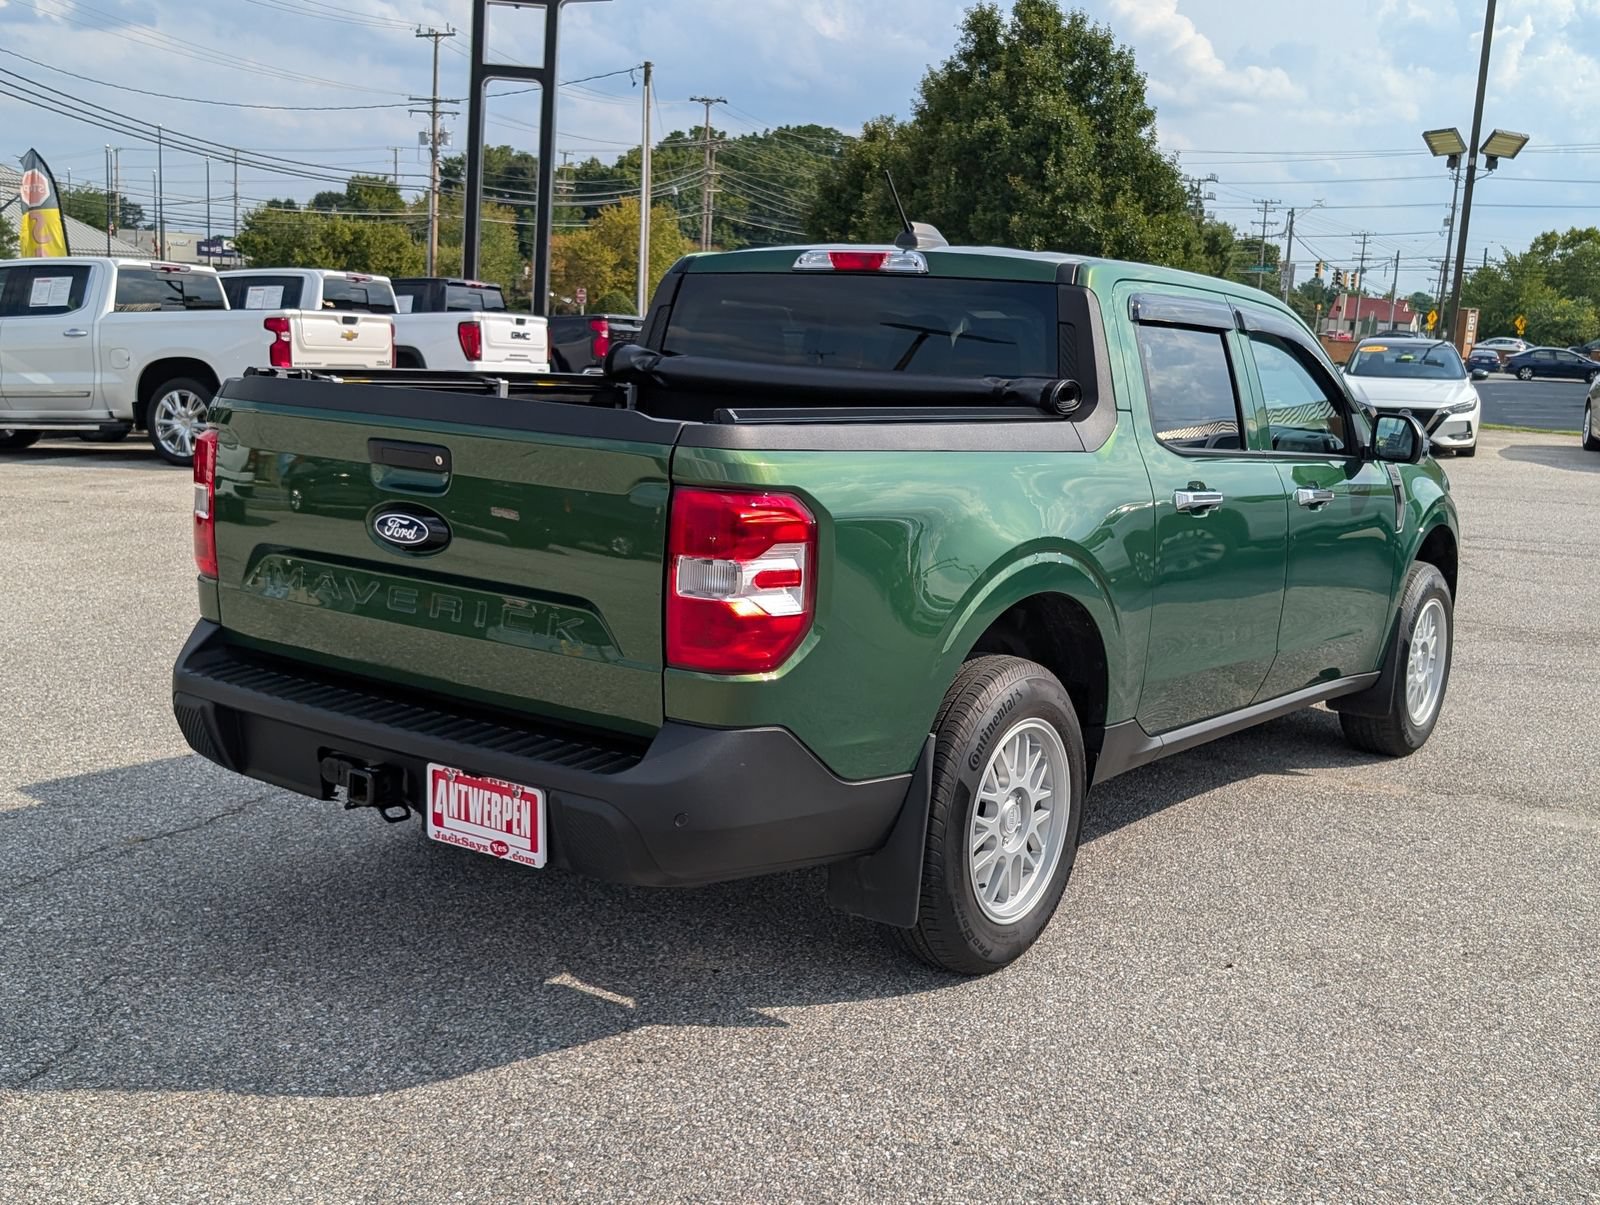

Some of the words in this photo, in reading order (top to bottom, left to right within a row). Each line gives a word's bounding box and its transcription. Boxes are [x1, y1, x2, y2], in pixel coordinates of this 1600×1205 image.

[511, 331, 531, 341] GMC
[384, 517, 418, 540] Ford
[267, 561, 585, 643] MAVERICK
[968, 693, 1016, 771] Continental
[434, 779, 531, 842] ANTWERPEN
